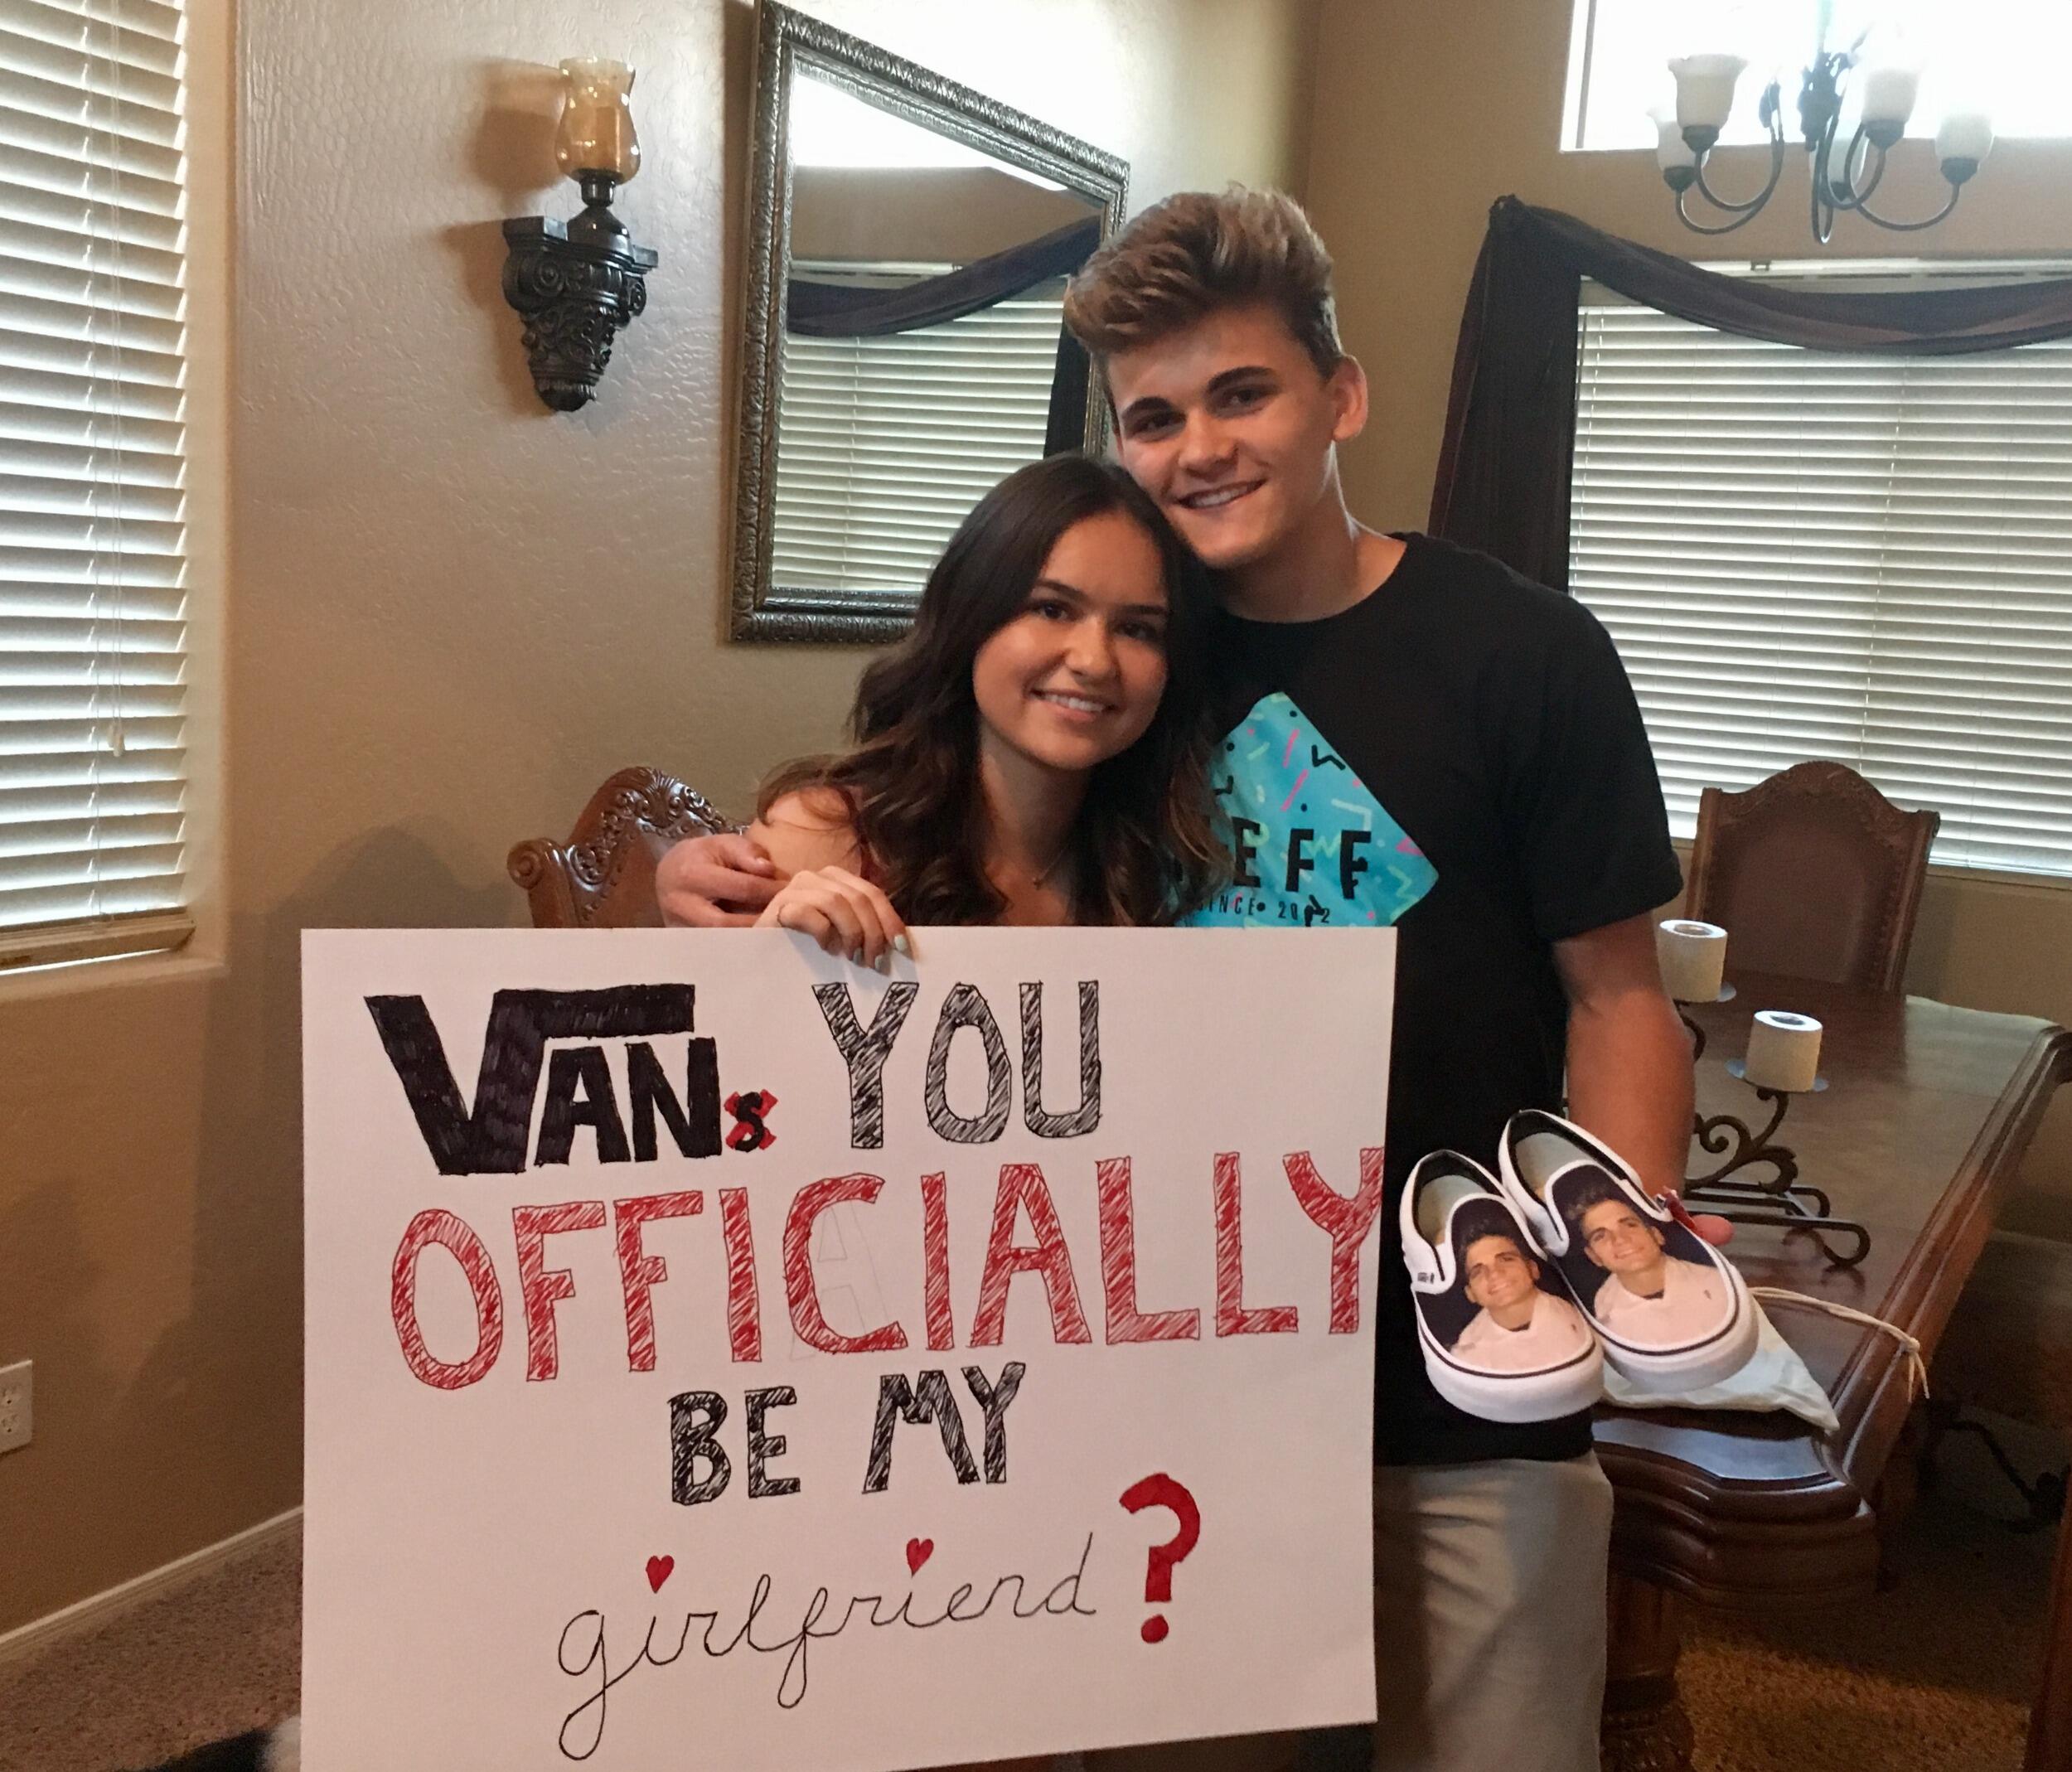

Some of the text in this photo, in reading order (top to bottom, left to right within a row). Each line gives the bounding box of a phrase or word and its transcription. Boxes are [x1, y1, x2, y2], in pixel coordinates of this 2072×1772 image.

[1198, 893, 1256, 916] INCE
[1232, 816, 1372, 900] EFF
[811, 980, 1101, 1149] YOU
[392, 1146, 1384, 1391] OFFICIALLY
[667, 1361, 1026, 1505] BE MY
